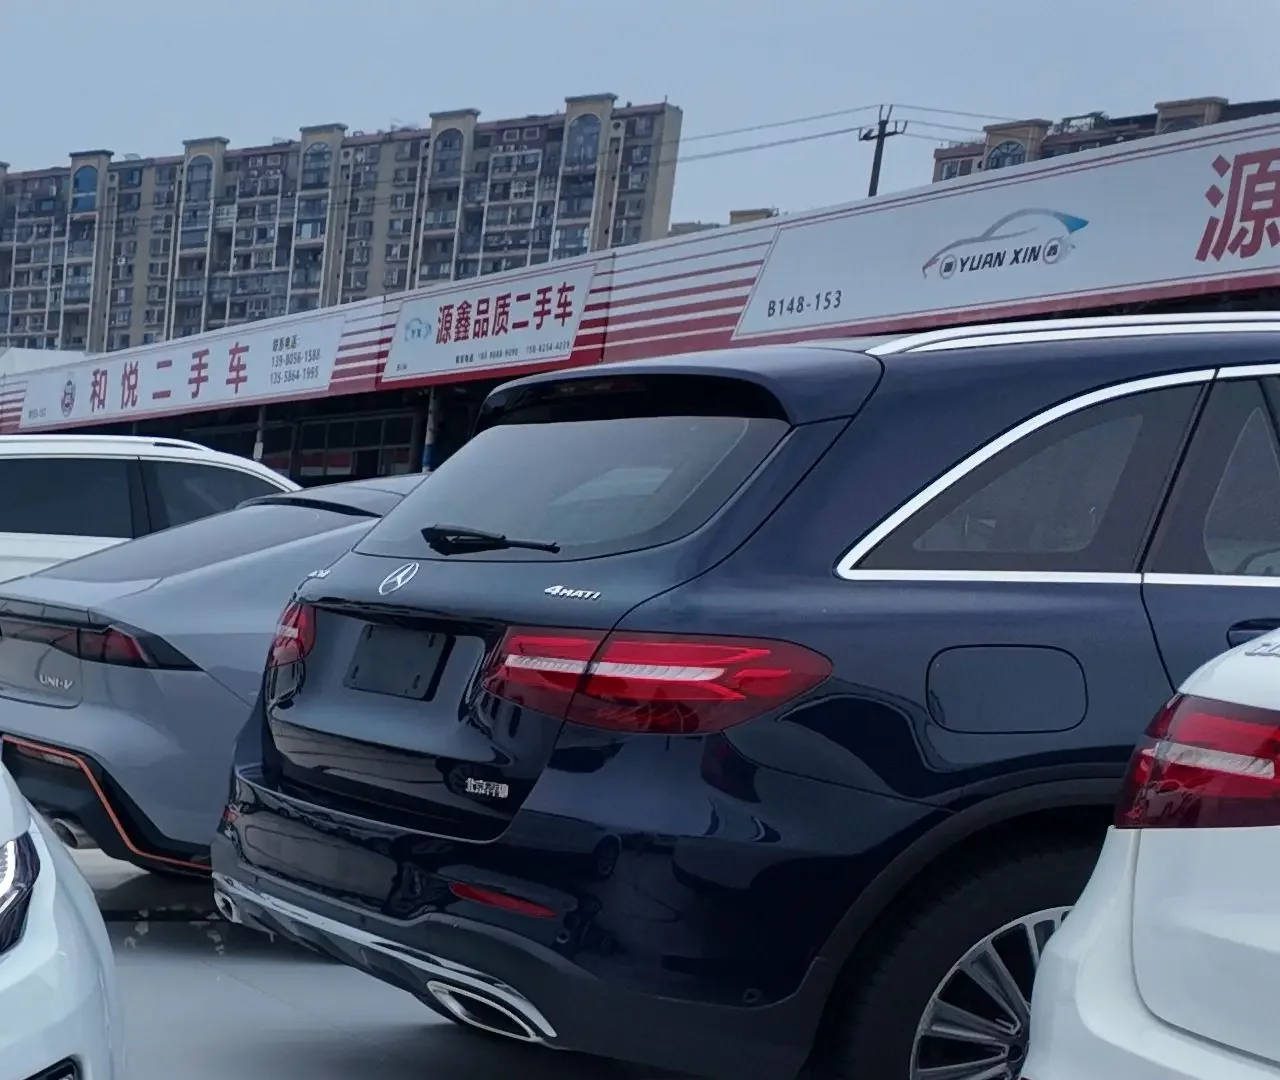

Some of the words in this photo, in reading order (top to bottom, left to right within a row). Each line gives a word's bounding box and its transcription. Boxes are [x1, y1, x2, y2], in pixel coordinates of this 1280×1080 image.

[1195, 147, 1280, 262] 源
[959, 251, 1007, 273] YUAN
[1010, 245, 1042, 266] XIN
[435, 281, 576, 345] 源鑫品质二手车
[767, 289, 842, 318] B148-153
[89, 341, 250, 413] 和悦二手车
[39, 674, 73, 691] UNI-V
